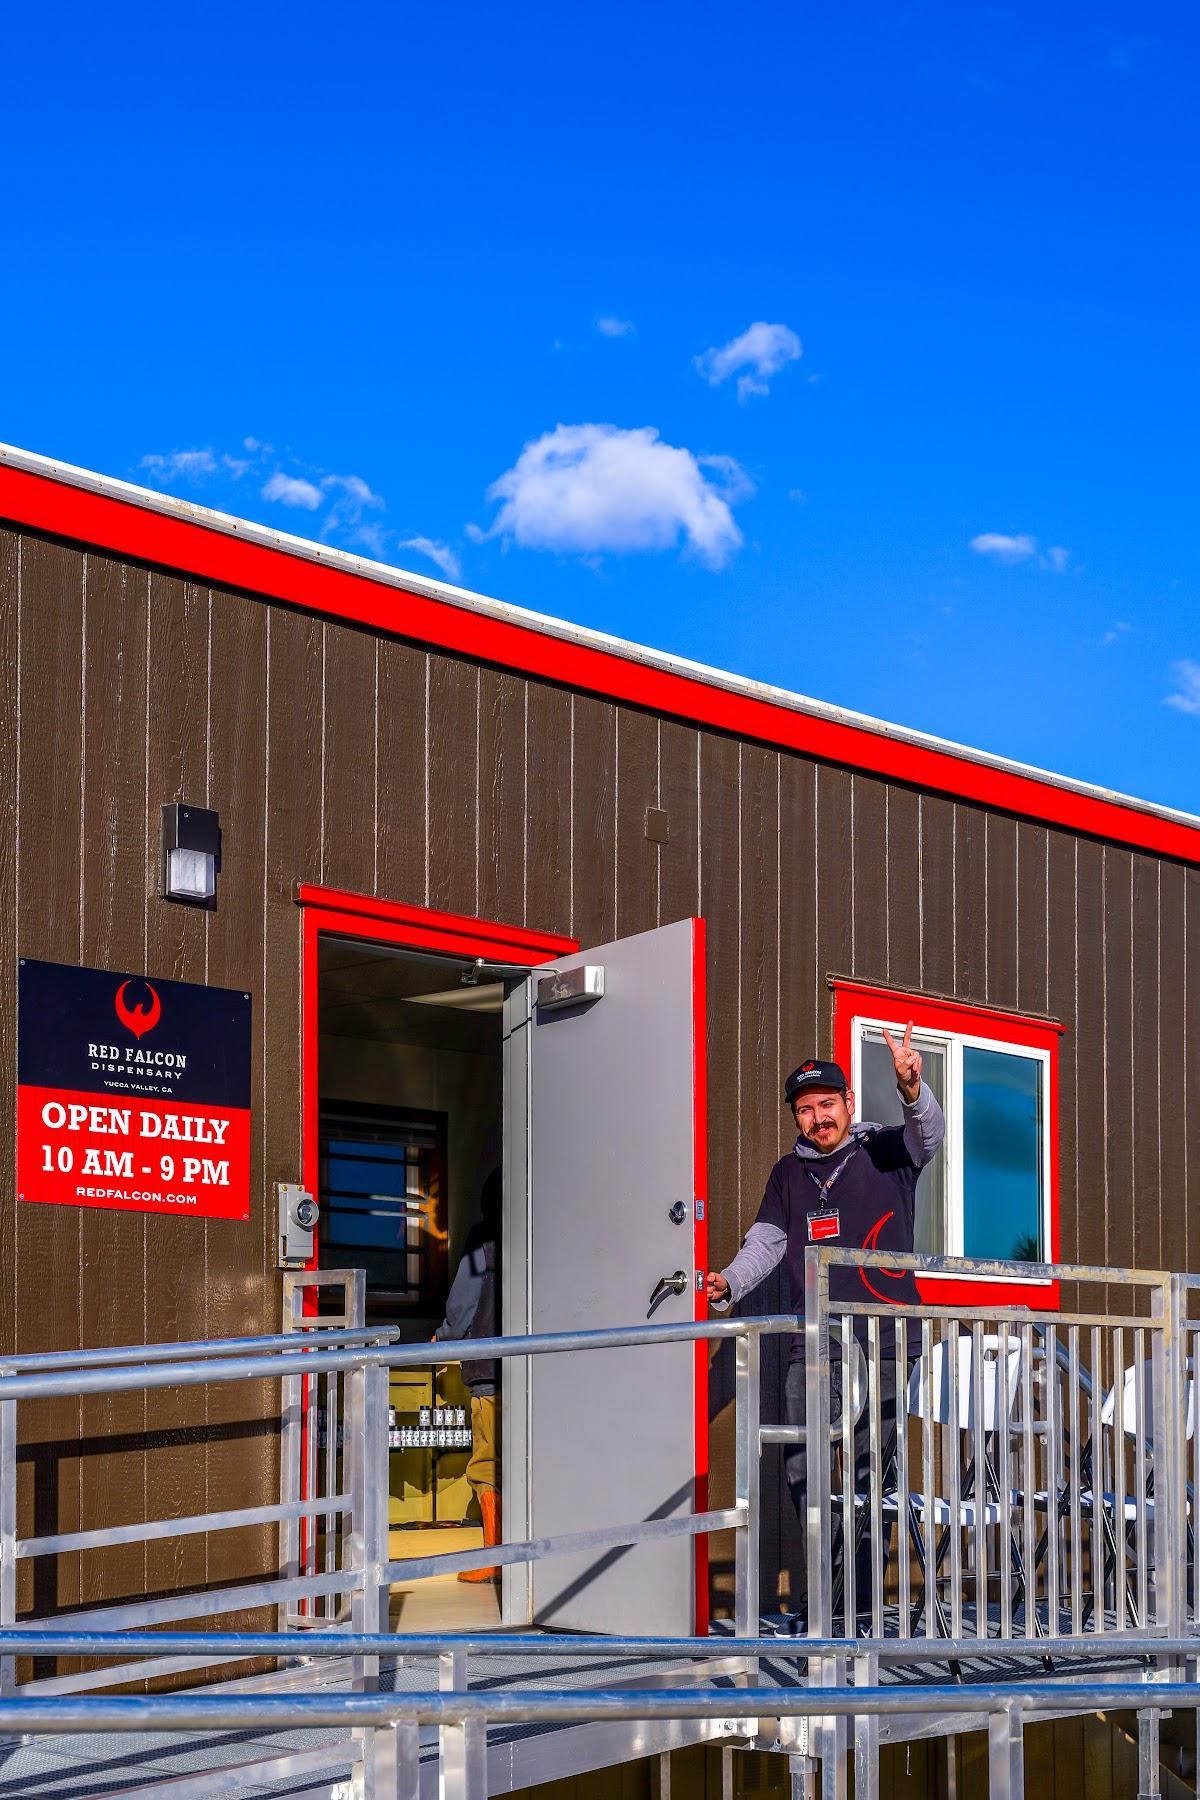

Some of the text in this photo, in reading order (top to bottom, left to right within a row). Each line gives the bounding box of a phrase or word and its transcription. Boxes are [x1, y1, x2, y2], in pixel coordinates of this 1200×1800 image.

[88, 1044, 187, 1068] RED FALCON
[92, 1063, 182, 1079] DISPENSARY
[104, 1081, 173, 1094] YUCCA VALLEY, CA
[42, 1102, 230, 1144] OPEN DAILY
[42, 1145, 74, 1172] 10
[81, 1149, 134, 1178] AM
[160, 1156, 175, 1181] 9
[183, 1158, 230, 1185] PM
[76, 1187, 197, 1204] REDFALCON.COM
